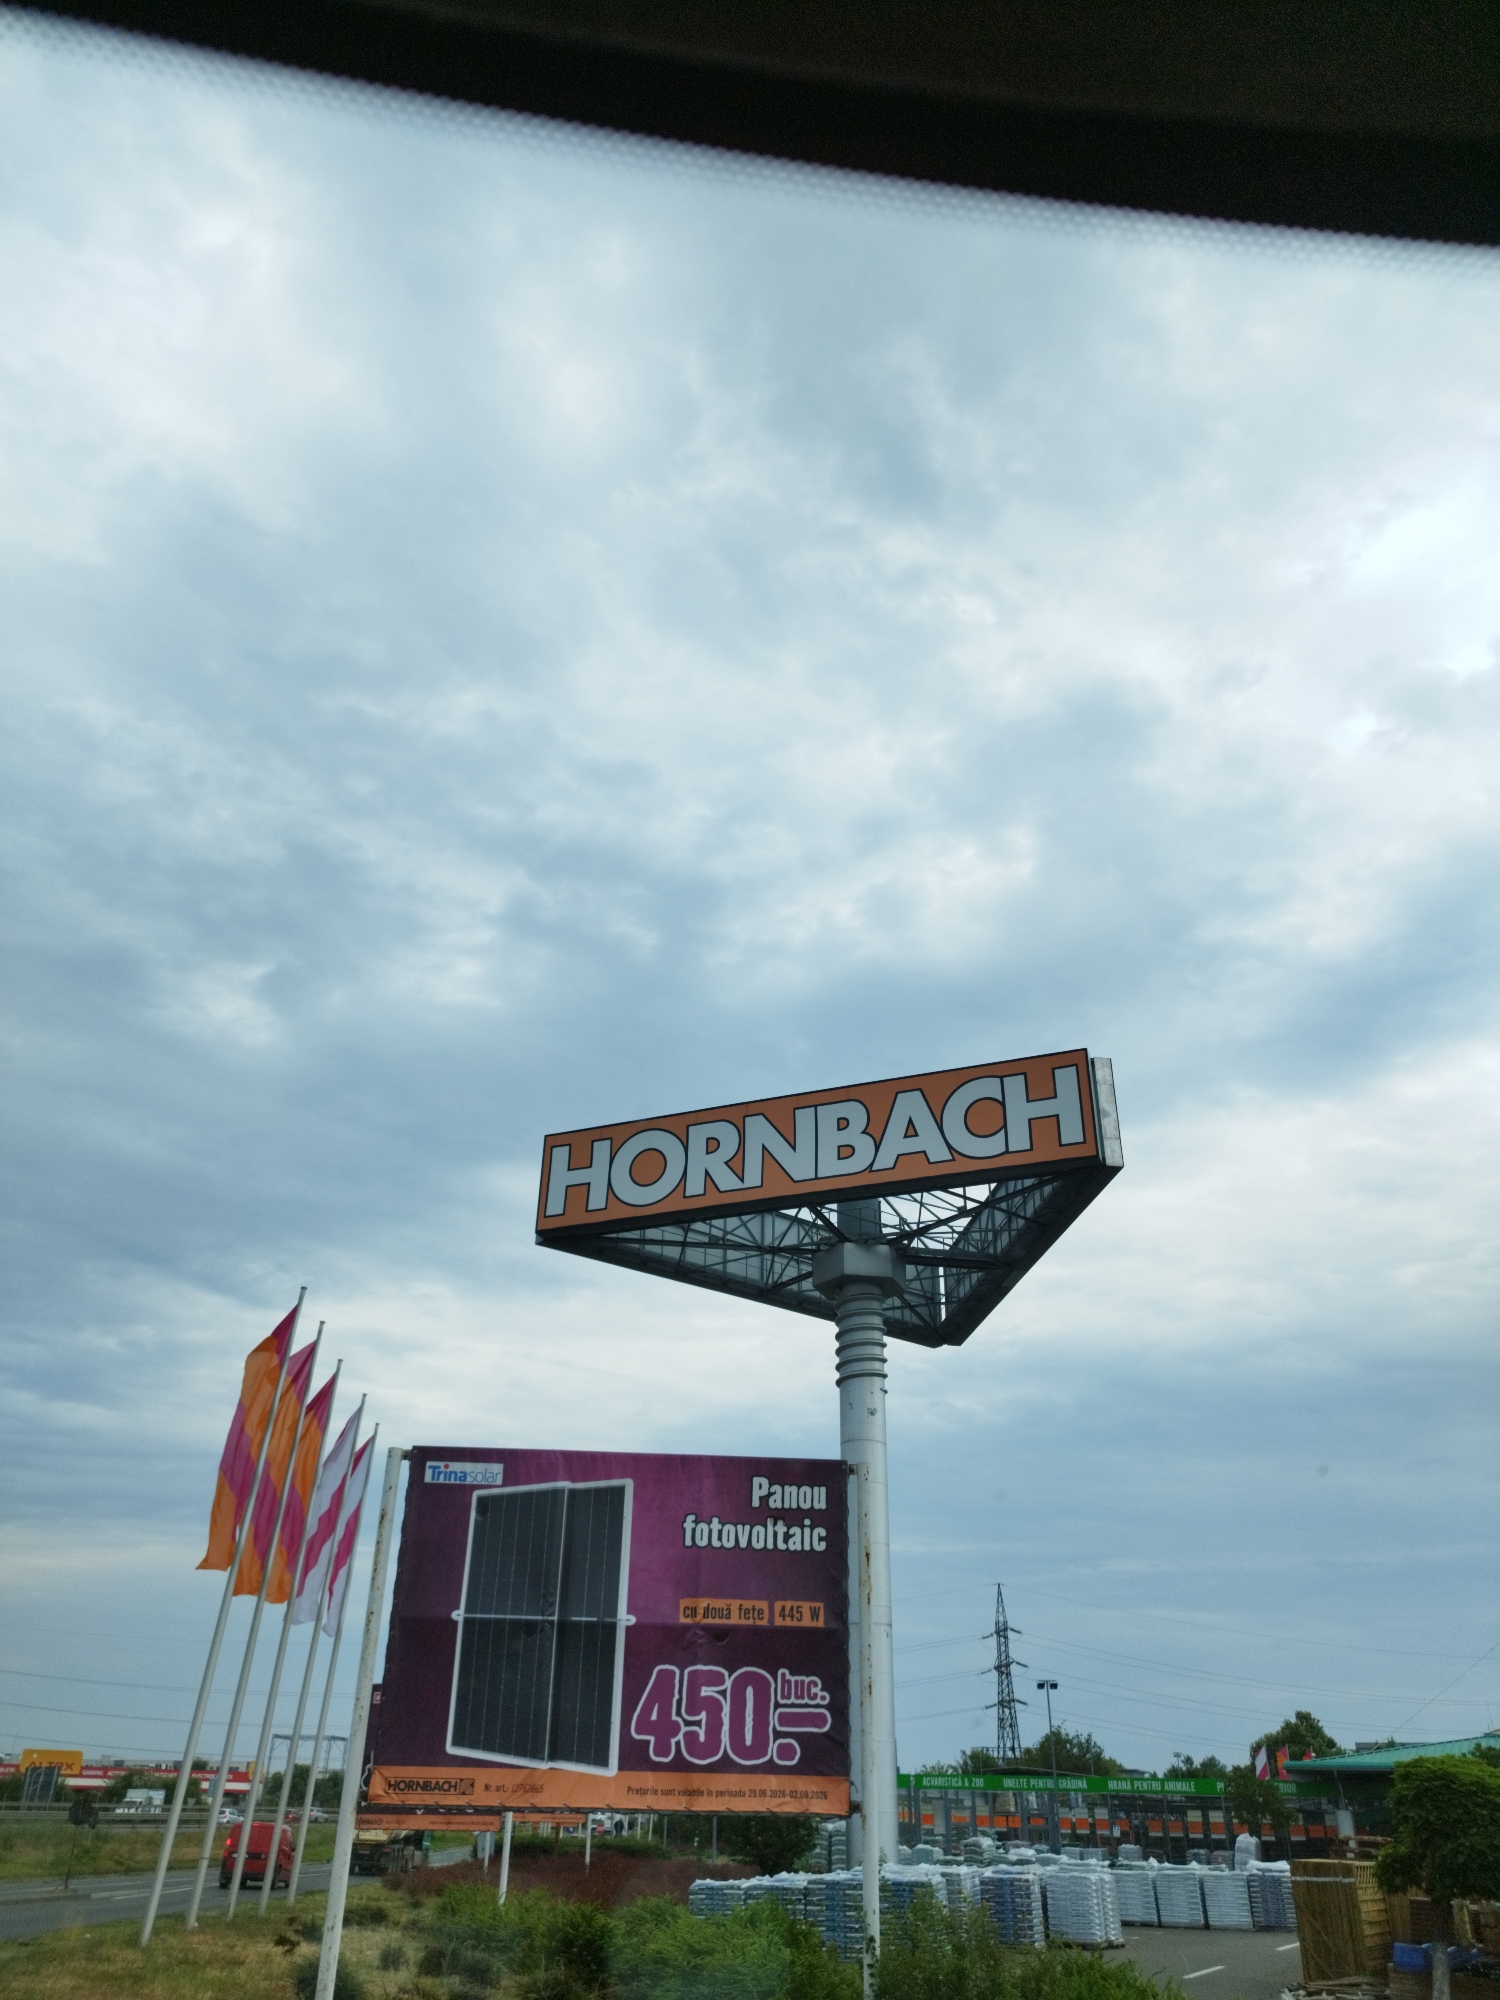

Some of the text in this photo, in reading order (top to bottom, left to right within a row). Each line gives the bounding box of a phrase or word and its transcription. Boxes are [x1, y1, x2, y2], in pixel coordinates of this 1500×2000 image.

[544, 1063, 1087, 1219] HORNBACH
[751, 1476, 827, 1510] Panou
[683, 1514, 827, 1552] fotovoltaic
[683, 1605, 698, 1619] cu
[703, 1603, 731, 1620] două
[779, 1605, 820, 1622] 445 W
[387, 1779, 458, 1793] HORNBACH
[484, 1782, 493, 1792] Nr.
[971, 1777, 984, 1788] ZOO
[1003, 1777, 1028, 1788] UNELTE
[1058, 1777, 1087, 1789] GRĂDINĂ
[1108, 1778, 1195, 1792] HRANĂ PENTRU ANIMALE
[660, 1787, 676, 1797] sunt
[677, 1786, 704, 1797] valabile
[715, 1787, 746, 1799] perioada
